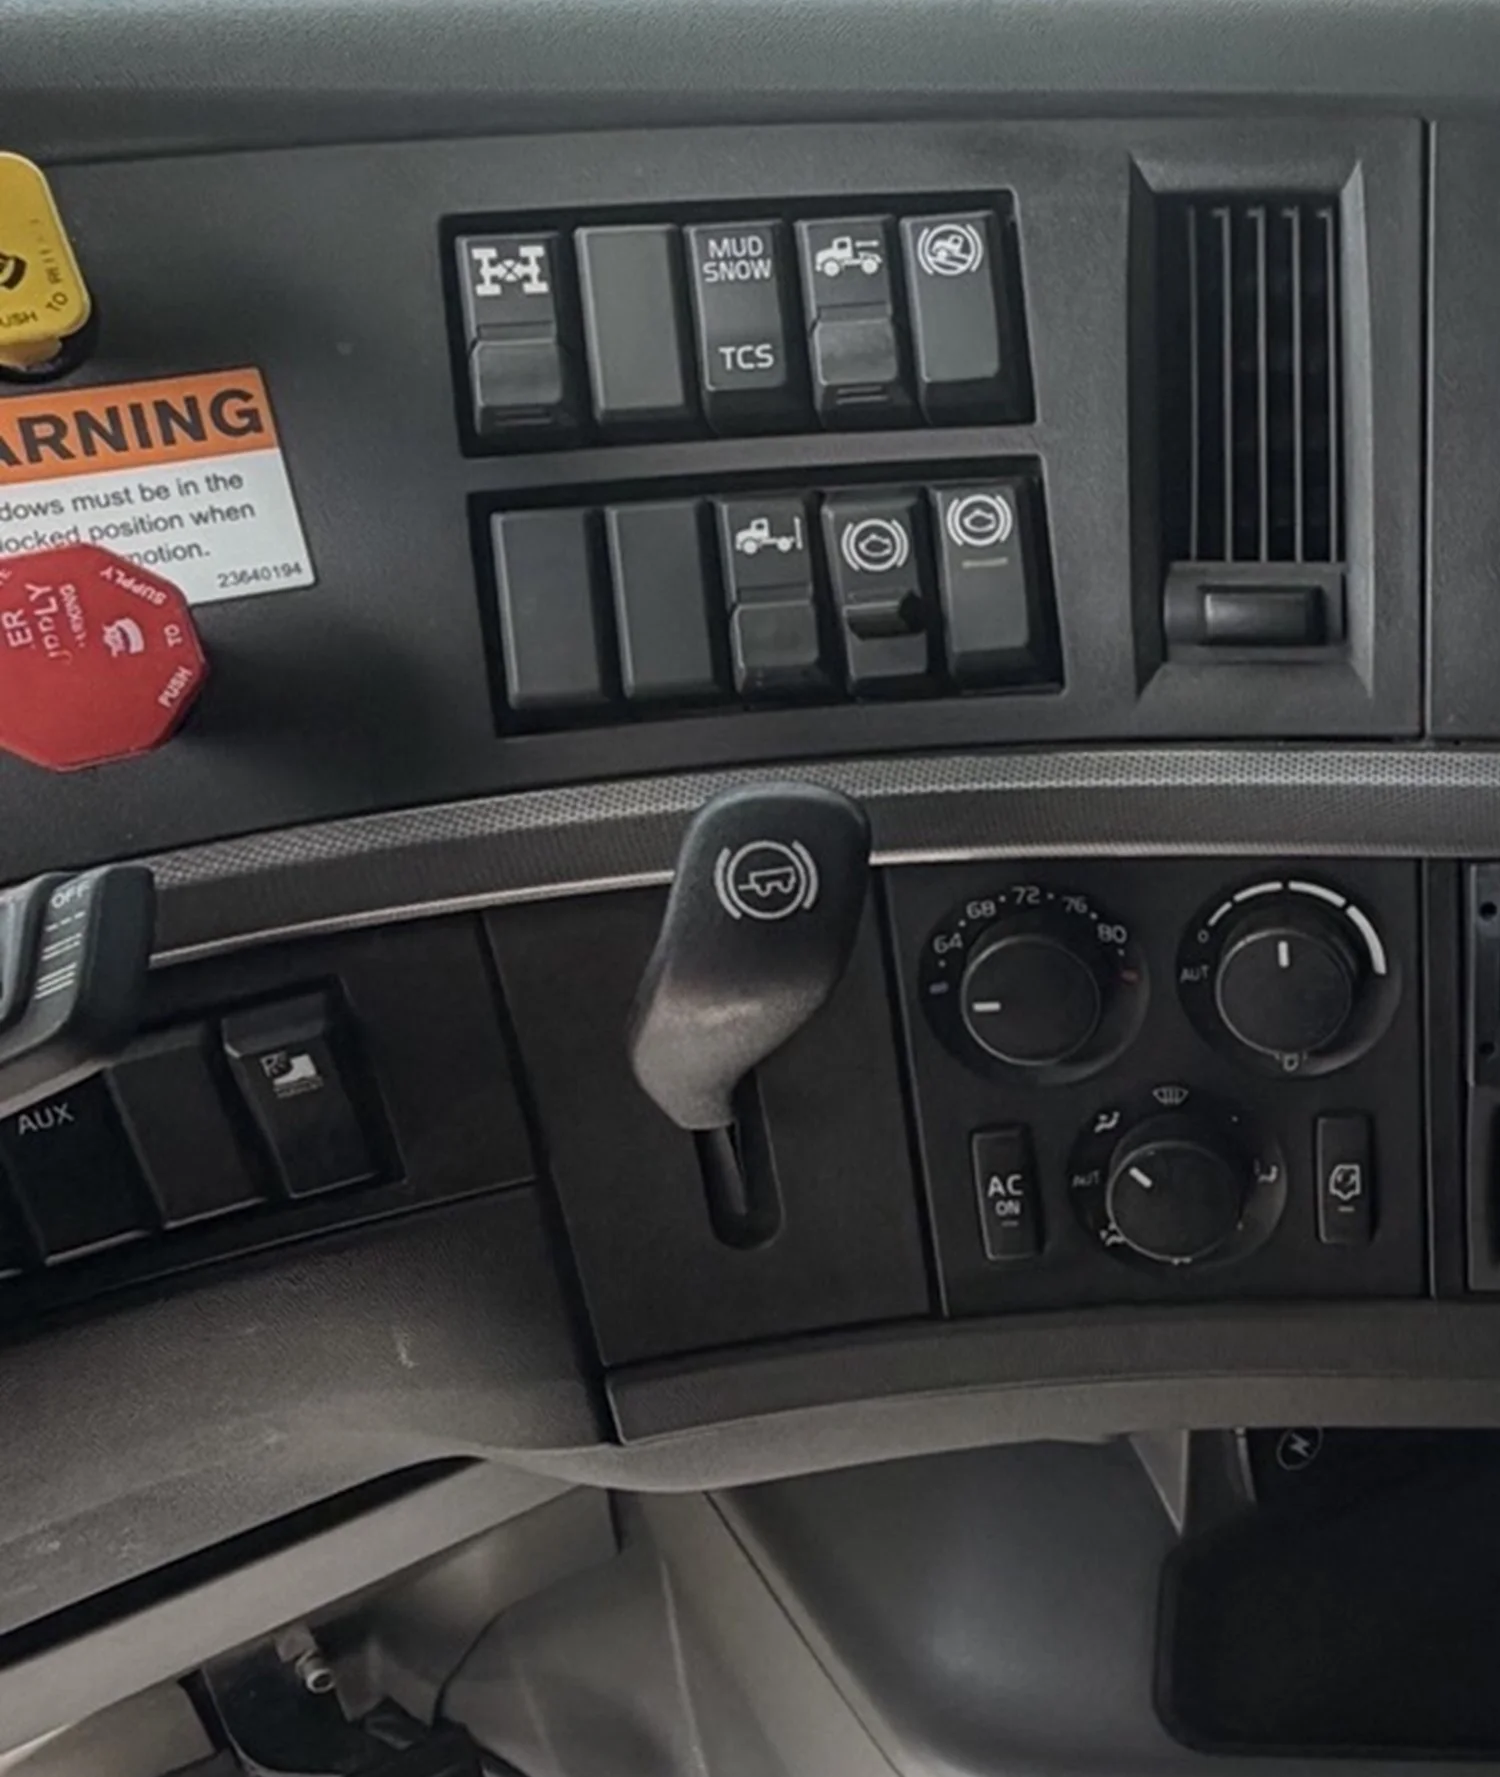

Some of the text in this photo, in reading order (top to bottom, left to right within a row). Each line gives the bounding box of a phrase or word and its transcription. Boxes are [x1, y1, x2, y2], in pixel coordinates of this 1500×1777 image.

[707, 234, 764, 258] MUD
[702, 258, 772, 282] SNOW
[45, 291, 69, 312] TO
[718, 343, 774, 370] TCS
[71, 487, 134, 512] must
[138, 482, 171, 502] be
[176, 477, 200, 497] in
[205, 473, 244, 493] the
[88, 513, 185, 544] position
[190, 503, 256, 526] when
[99, 565, 193, 708] PUSH TO SUPPLY
[51, 879, 91, 909] OFF
[1011, 885, 1041, 905] 72
[1062, 895, 1088, 914] 76
[965, 899, 996, 919] 68
[933, 932, 964, 954] 64
[1097, 923, 1127, 944] 80
[18, 1102, 75, 1136] AUX
[987, 1173, 1024, 1198] AC
[995, 1200, 1021, 1216] ON
